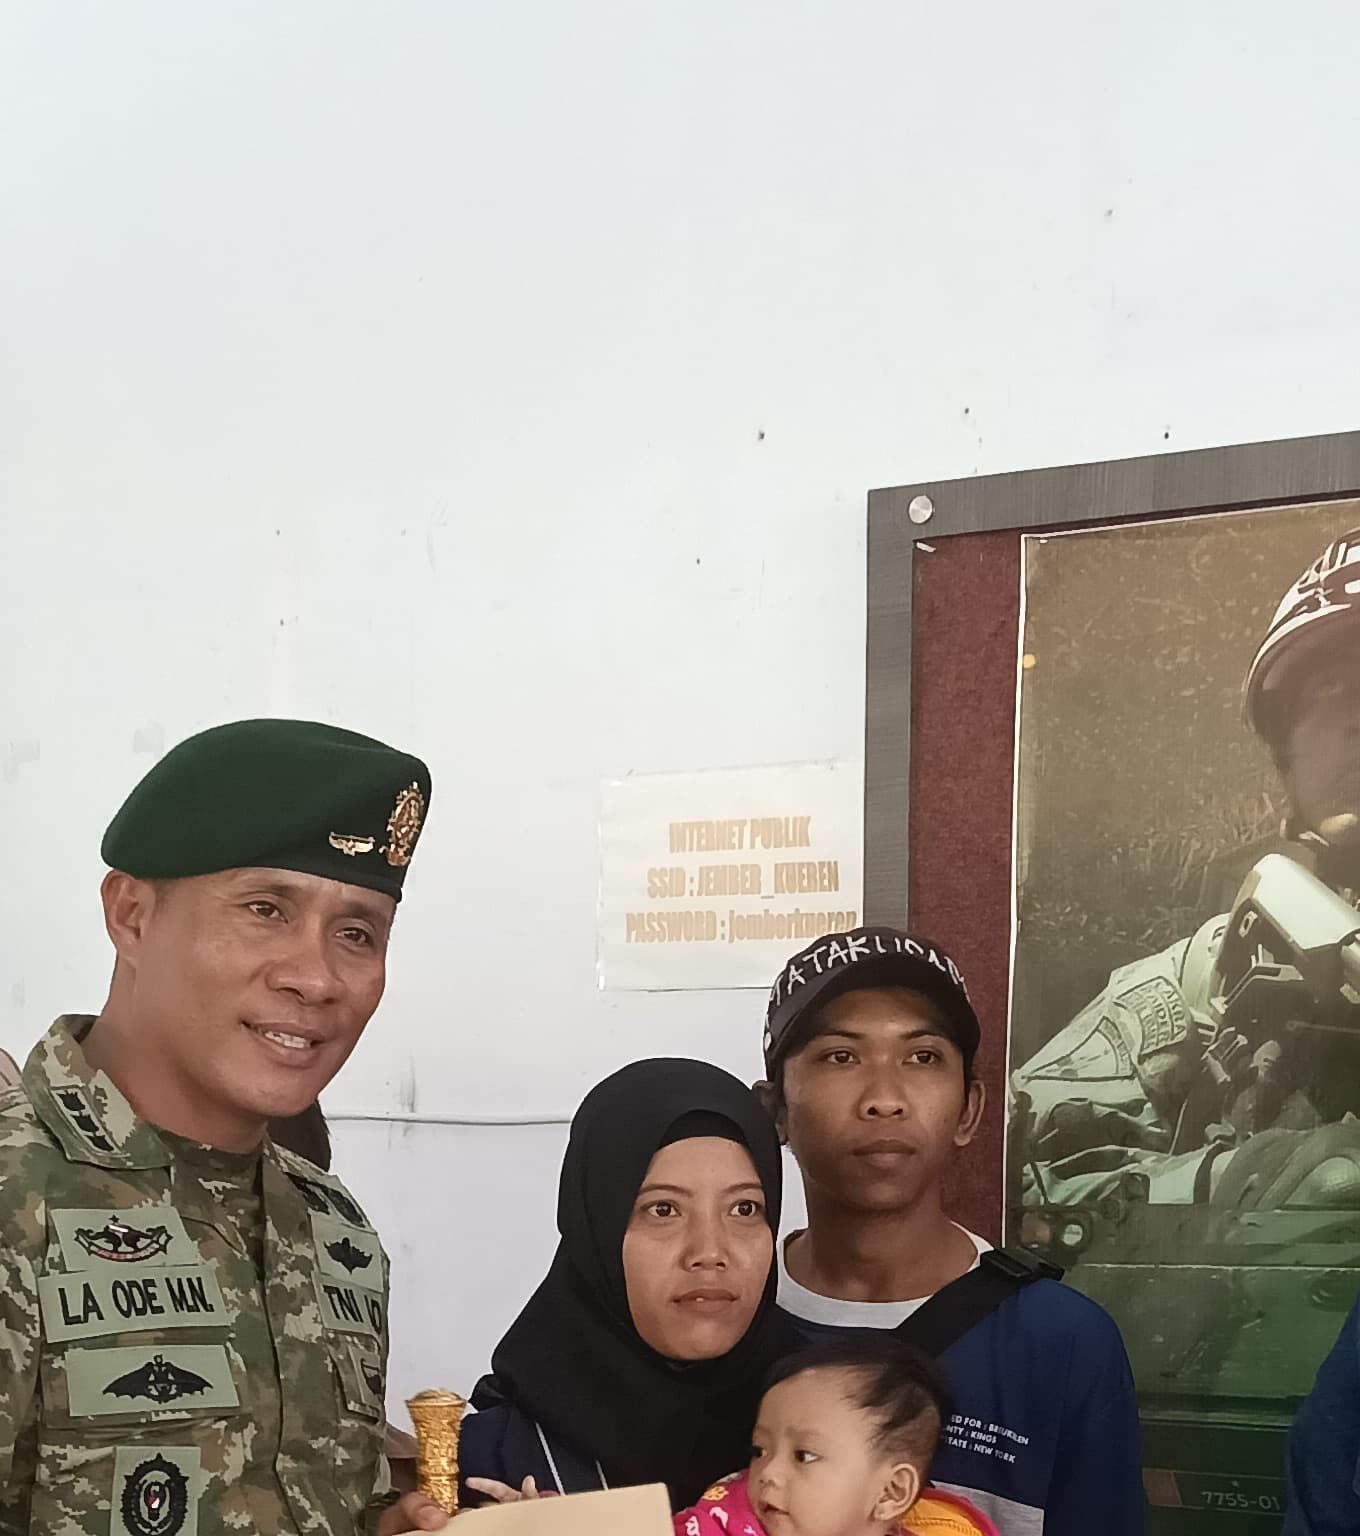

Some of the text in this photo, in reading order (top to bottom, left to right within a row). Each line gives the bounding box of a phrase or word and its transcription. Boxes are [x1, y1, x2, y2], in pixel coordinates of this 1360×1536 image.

[669, 815, 812, 853] INTERNET PUBLIK
[647, 867, 686, 898] SSID
[626, 910, 717, 943] PASSWORD
[58, 1282, 105, 1326] LA
[111, 1278, 166, 1319] ODE
[322, 1284, 365, 1323] TNI
[963, 1417, 982, 1429] FOR
[970, 1430, 997, 1444] KINGS
[973, 1443, 993, 1455] NEW
[994, 1449, 1016, 1464] YORK
